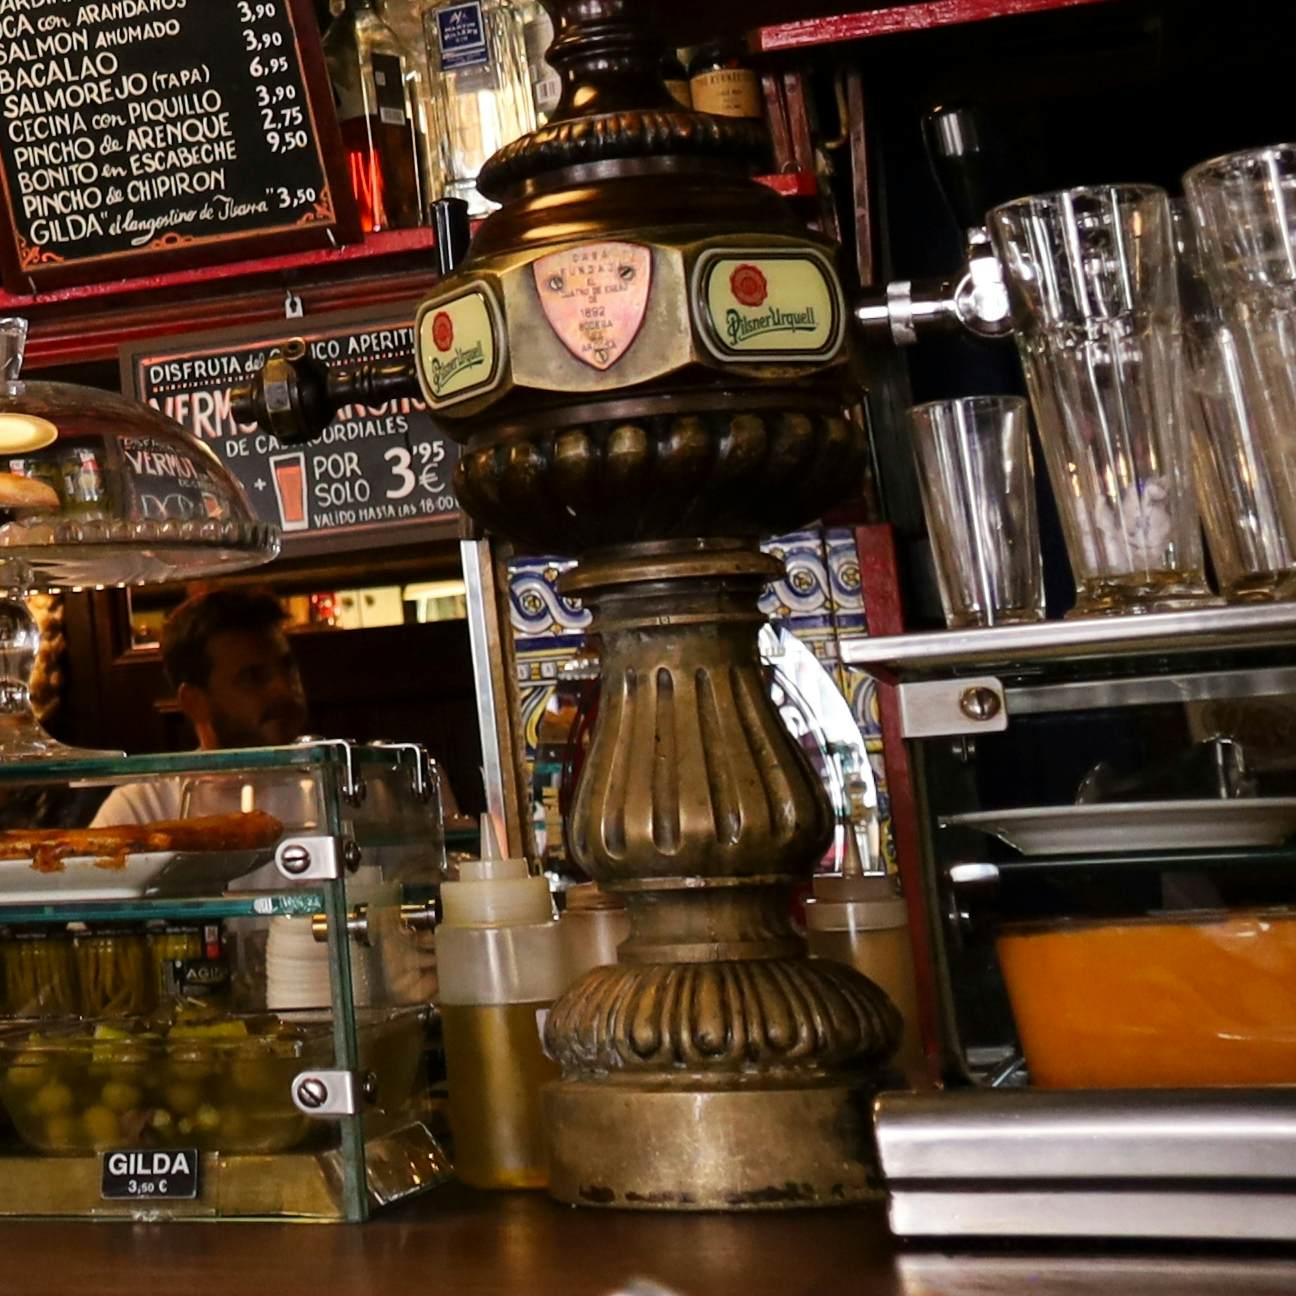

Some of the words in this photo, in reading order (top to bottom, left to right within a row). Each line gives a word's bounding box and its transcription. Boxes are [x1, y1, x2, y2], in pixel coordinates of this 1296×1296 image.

[242, 29, 283, 51] 3,90
[3, 72, 148, 119] SALMOREJO
[249, 55, 289, 78] 6,95
[17, 161, 99, 194] BONITO
[129, 139, 237, 176] ESCABECHE
[266, 130, 308, 154] 9,50
[149, 355, 238, 385] DISFRUTA
[313, 451, 363, 481] POR
[314, 478, 371, 508] SOLO
[108, 1151, 190, 1177] GILDA
[126, 1179, 156, 1195] 3,50
[157, 1179, 168, 1194] €
